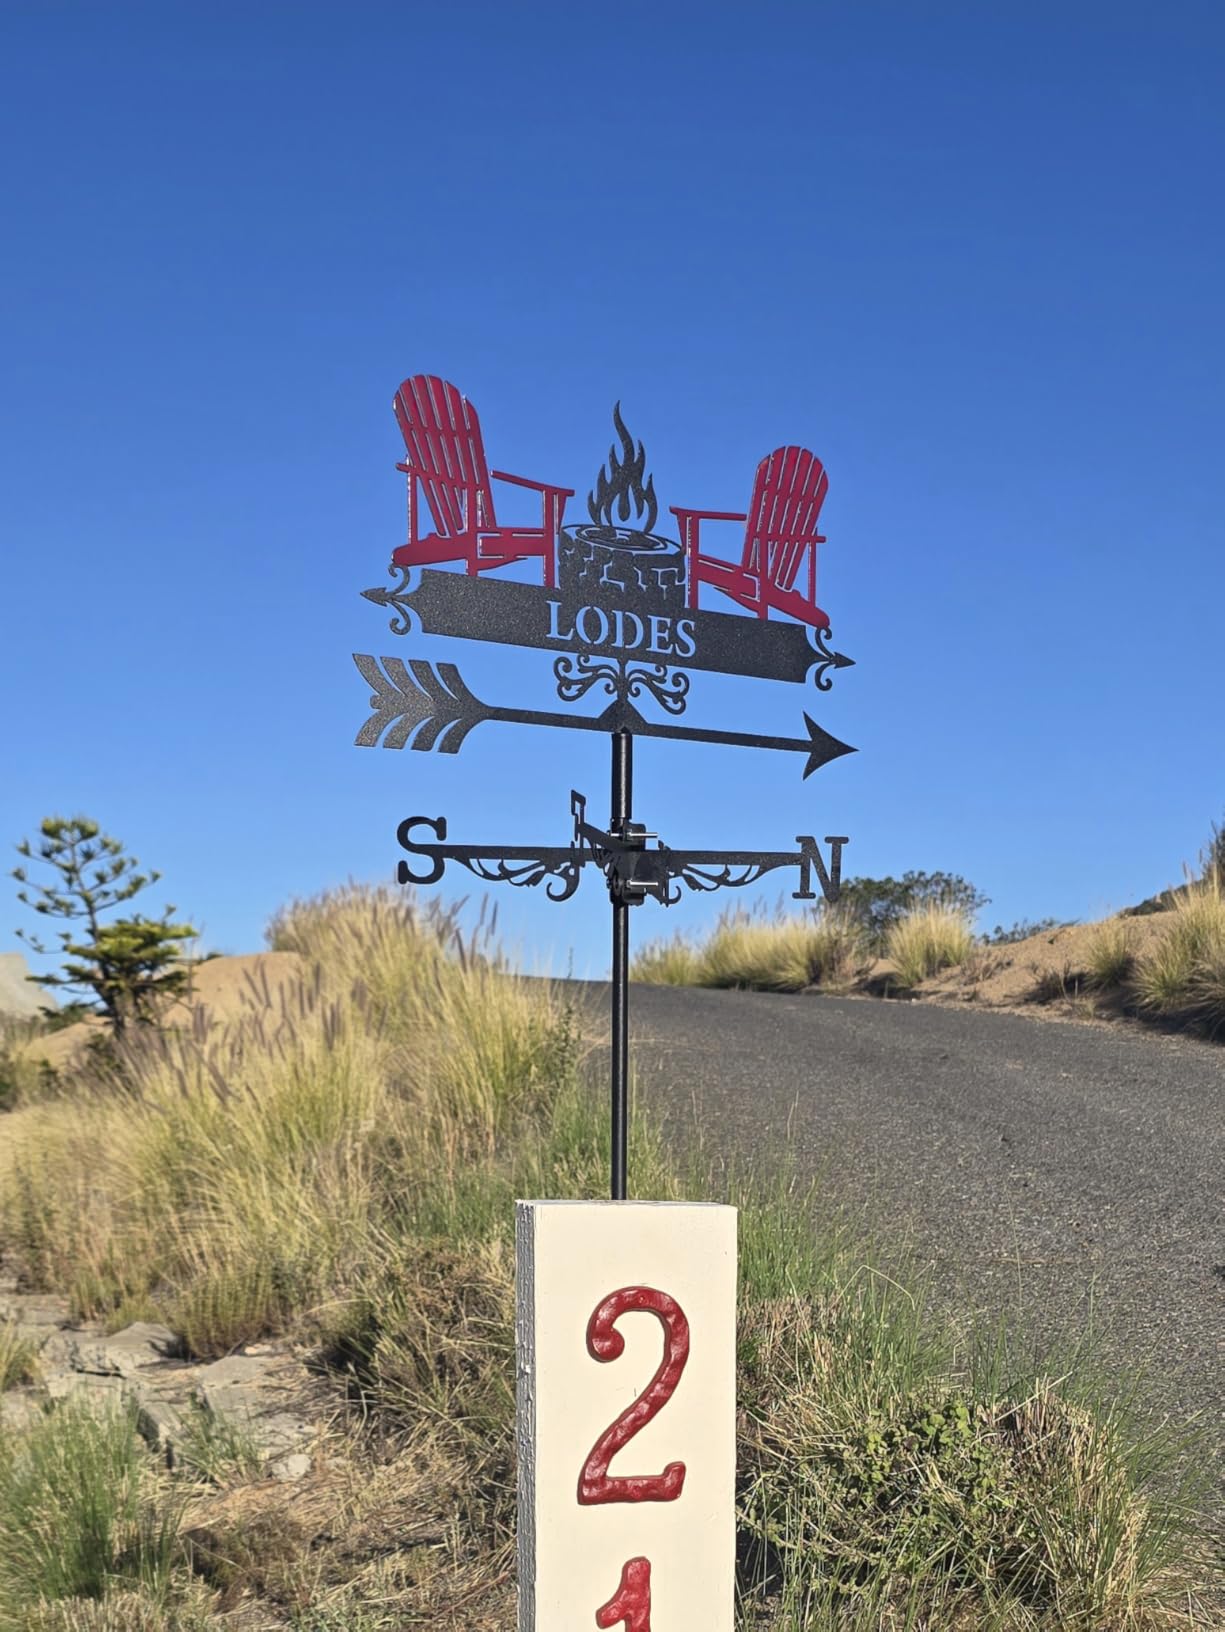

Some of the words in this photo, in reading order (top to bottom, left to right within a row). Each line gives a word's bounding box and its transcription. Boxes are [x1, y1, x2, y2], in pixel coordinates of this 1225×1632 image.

[545, 600, 697, 658] LODES
[397, 816, 447, 885] S
[792, 836, 849, 902] N
